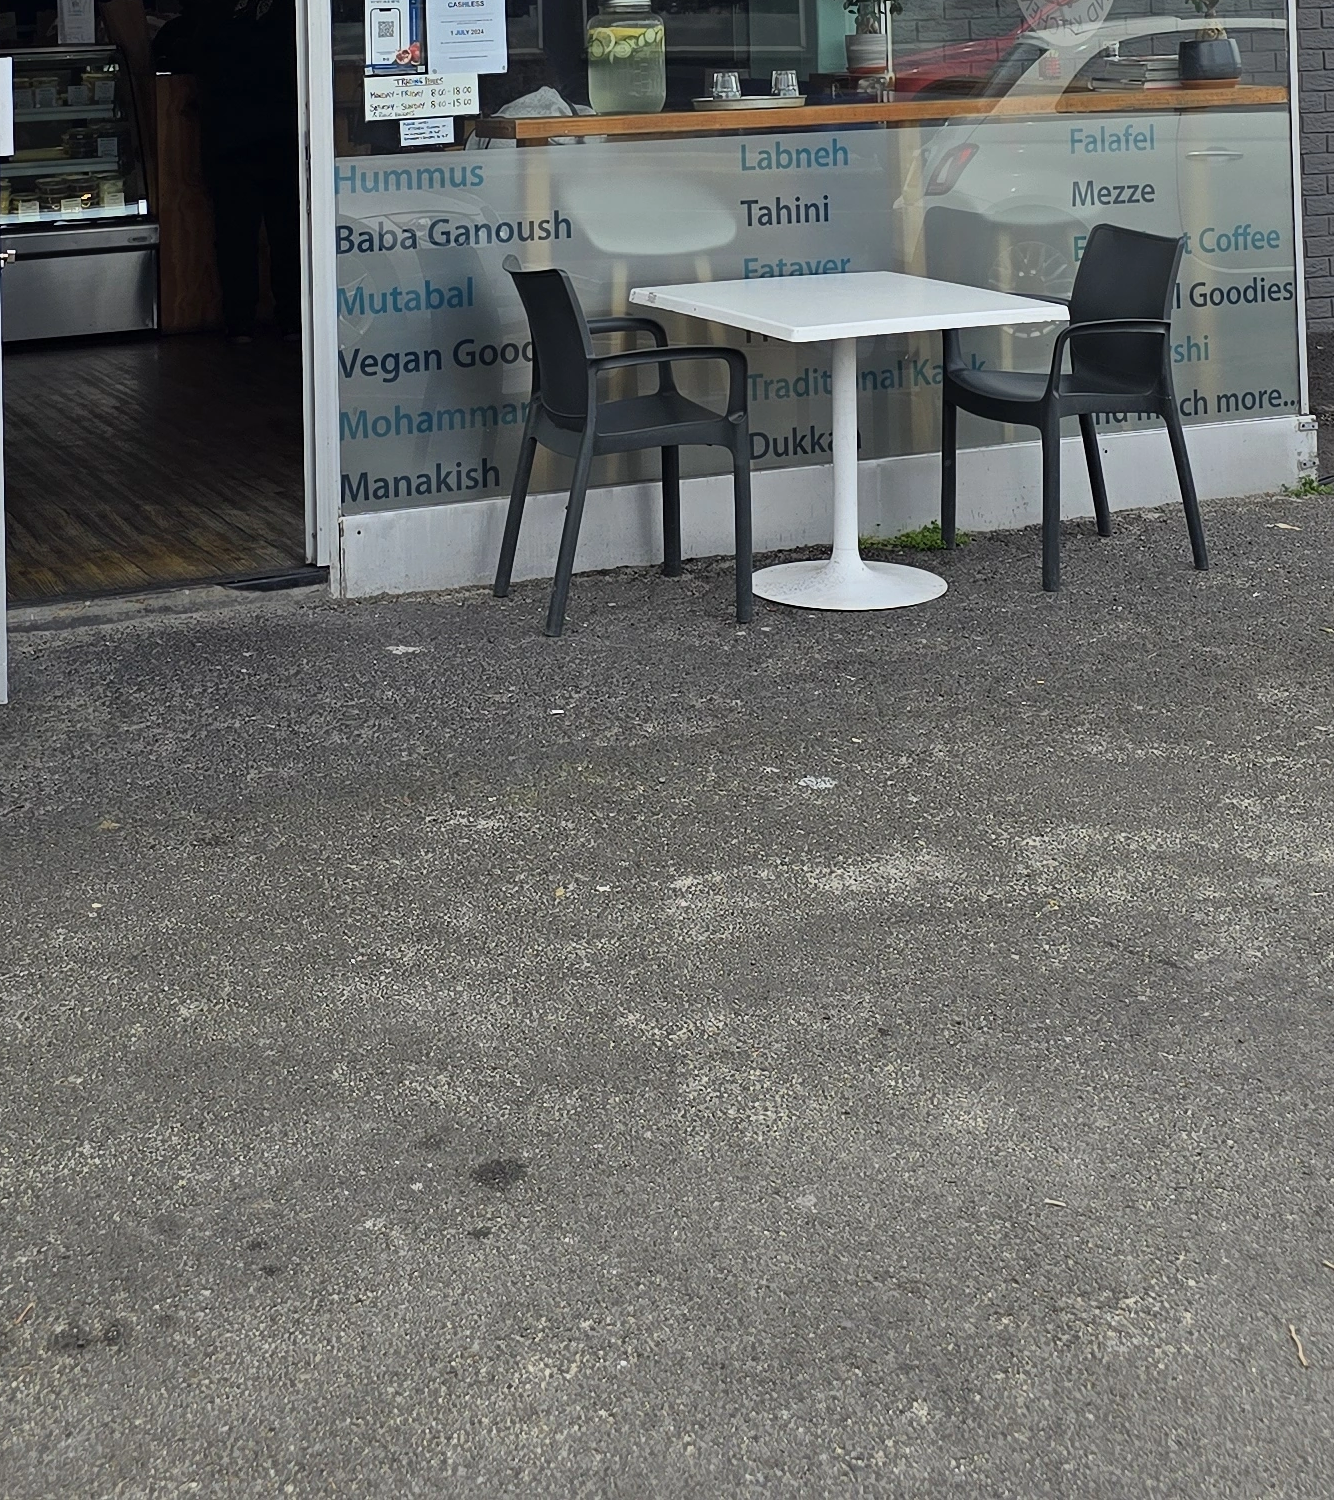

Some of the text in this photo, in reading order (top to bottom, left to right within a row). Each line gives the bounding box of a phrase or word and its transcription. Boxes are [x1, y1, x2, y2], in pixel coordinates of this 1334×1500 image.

[447, 0, 485, 9] CASHLESS
[740, 137, 850, 172] Labneh
[1069, 123, 1156, 155] Falafel
[335, 164, 485, 195] Hummus
[1071, 179, 1156, 207] Mezze
[739, 194, 829, 227] Tahini
[336, 209, 573, 255] Baba Ganoush
[1198, 223, 1281, 254] Coffee
[336, 275, 475, 317] Mutabal
[1189, 276, 1294, 308] Goodies
[338, 348, 443, 383] Vegan
[748, 359, 903, 401] Traditnal
[339, 400, 531, 442] Mohammar
[340, 457, 501, 505] Manakish
